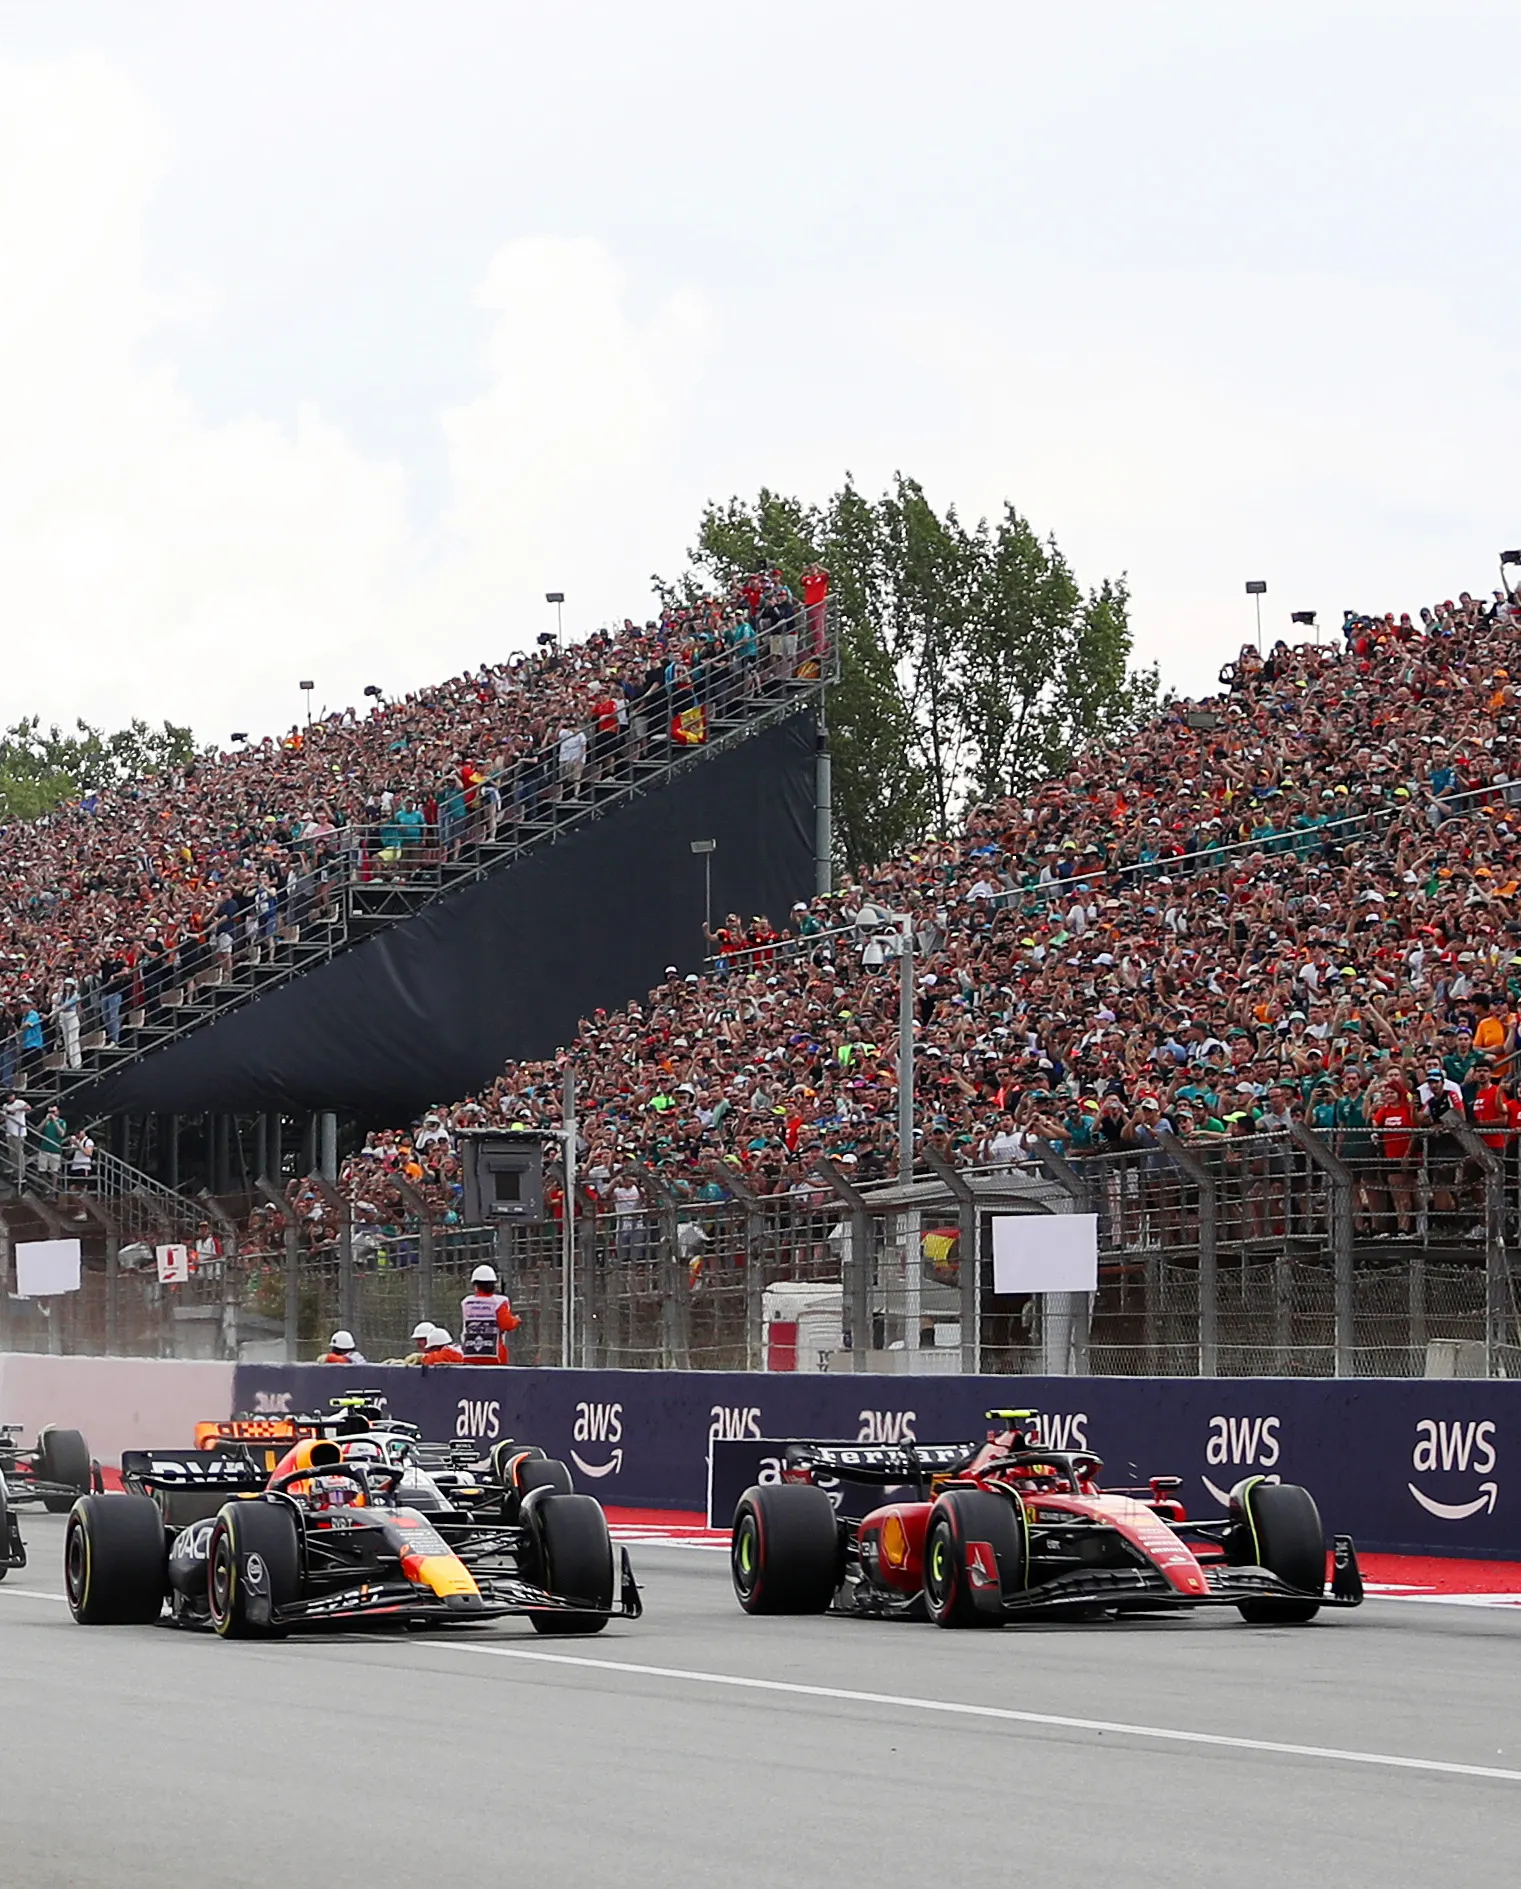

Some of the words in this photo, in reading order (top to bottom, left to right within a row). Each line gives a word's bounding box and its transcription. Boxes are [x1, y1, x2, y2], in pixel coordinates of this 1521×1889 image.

[455, 1398, 501, 1439] aws
[573, 1401, 623, 1443] aws
[709, 1405, 762, 1440] aws
[858, 1409, 917, 1443] aws
[1024, 1412, 1089, 1451] aws
[1205, 1415, 1281, 1467] aws
[1412, 1419, 1497, 1474] aws
